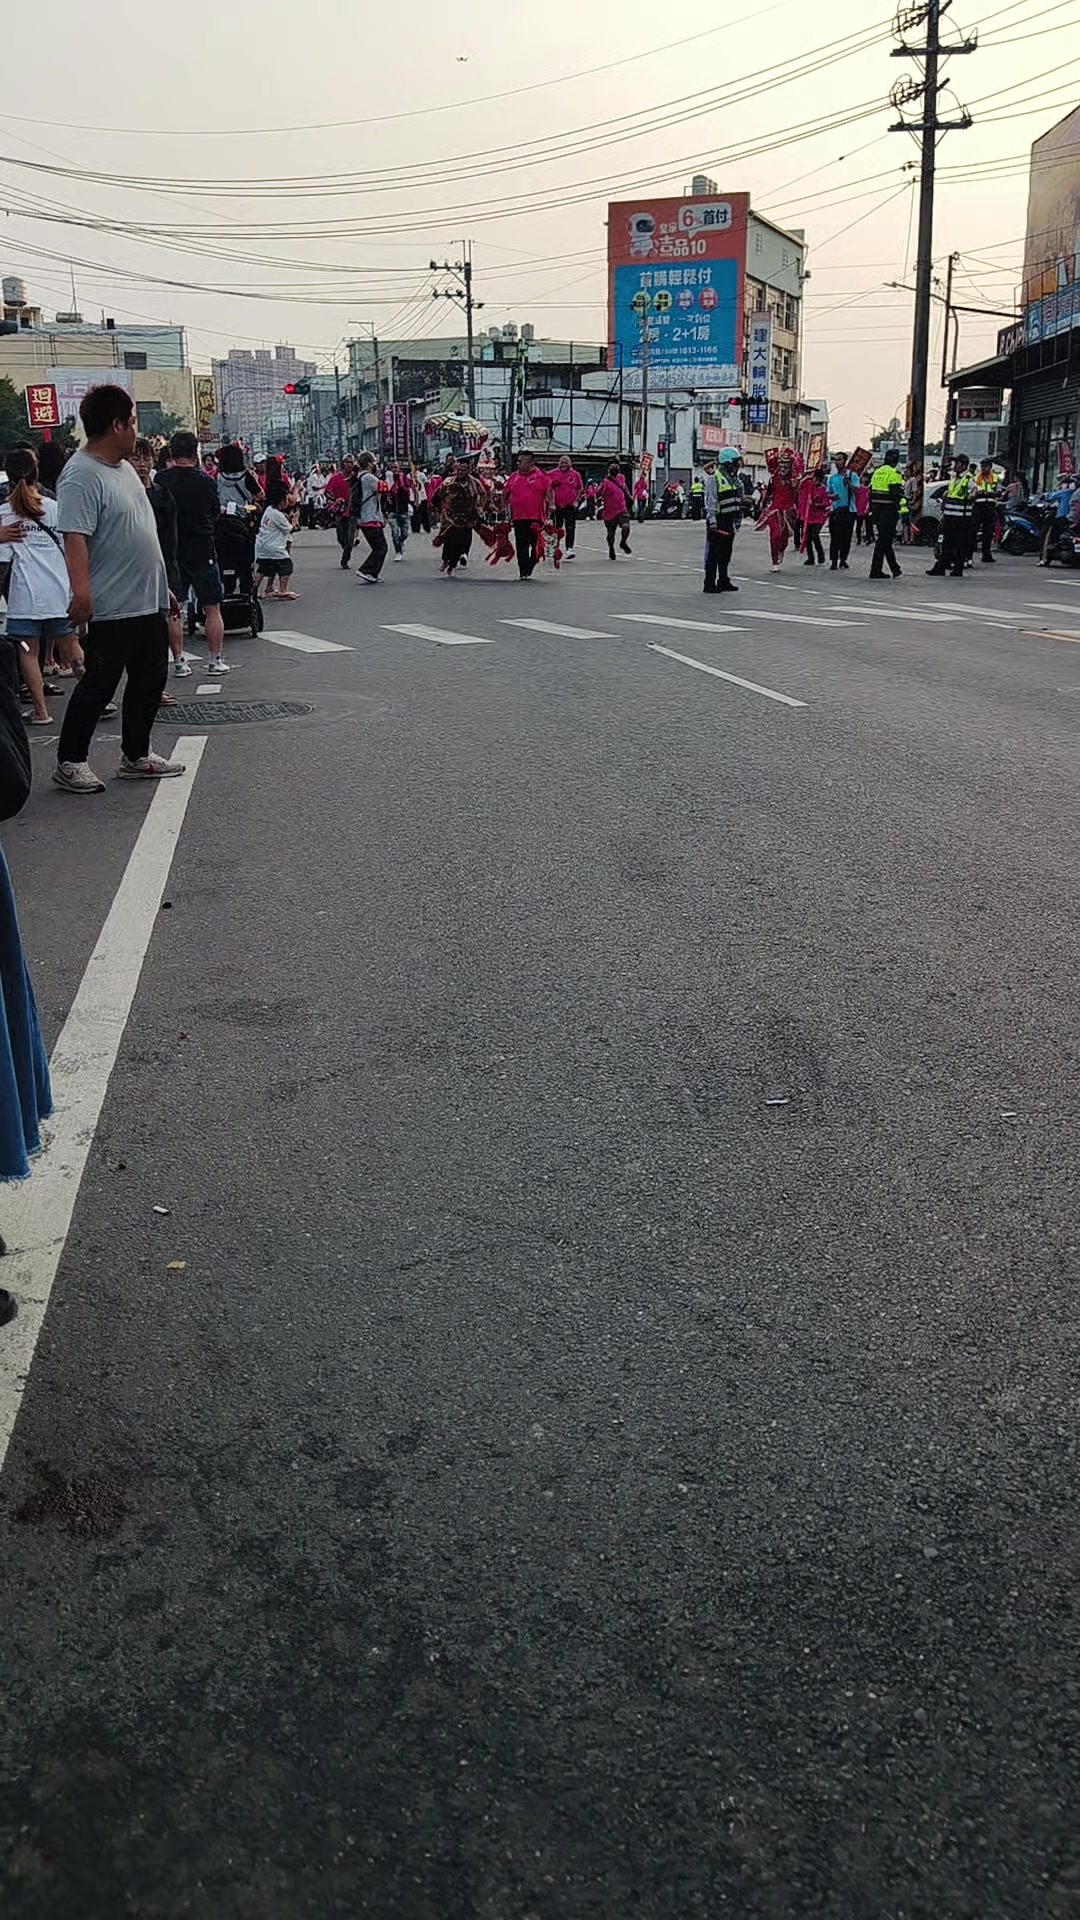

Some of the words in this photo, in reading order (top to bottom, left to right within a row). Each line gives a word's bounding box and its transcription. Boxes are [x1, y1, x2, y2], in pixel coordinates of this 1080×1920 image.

[752, 328, 768, 400] 建大輪胎
[32, 387, 54, 423] 迴避
